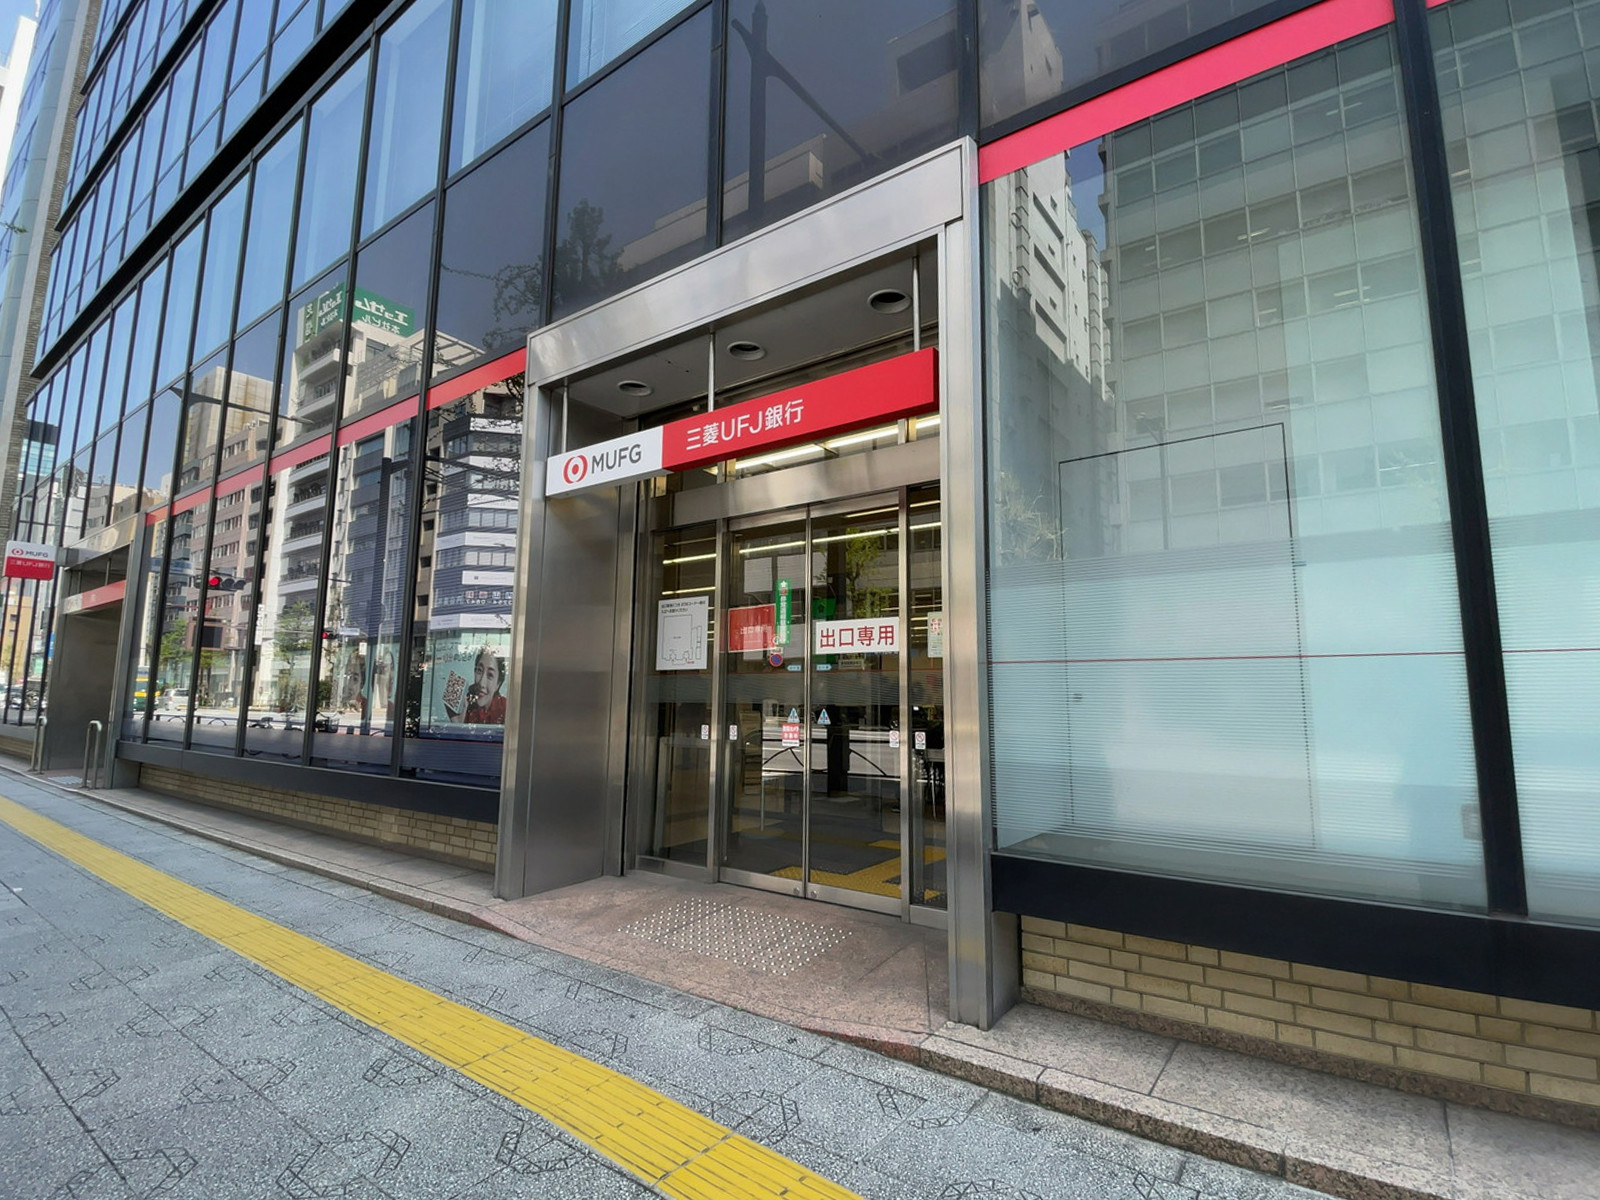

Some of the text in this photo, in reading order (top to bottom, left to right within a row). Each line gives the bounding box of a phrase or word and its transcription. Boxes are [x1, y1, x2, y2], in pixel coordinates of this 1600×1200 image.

[685, 399, 805, 451] 三菱UFJ銀行
[591, 443, 642, 475] MUFG
[25, 550, 48, 558] MUFG
[819, 625, 895, 648] 出口専用
